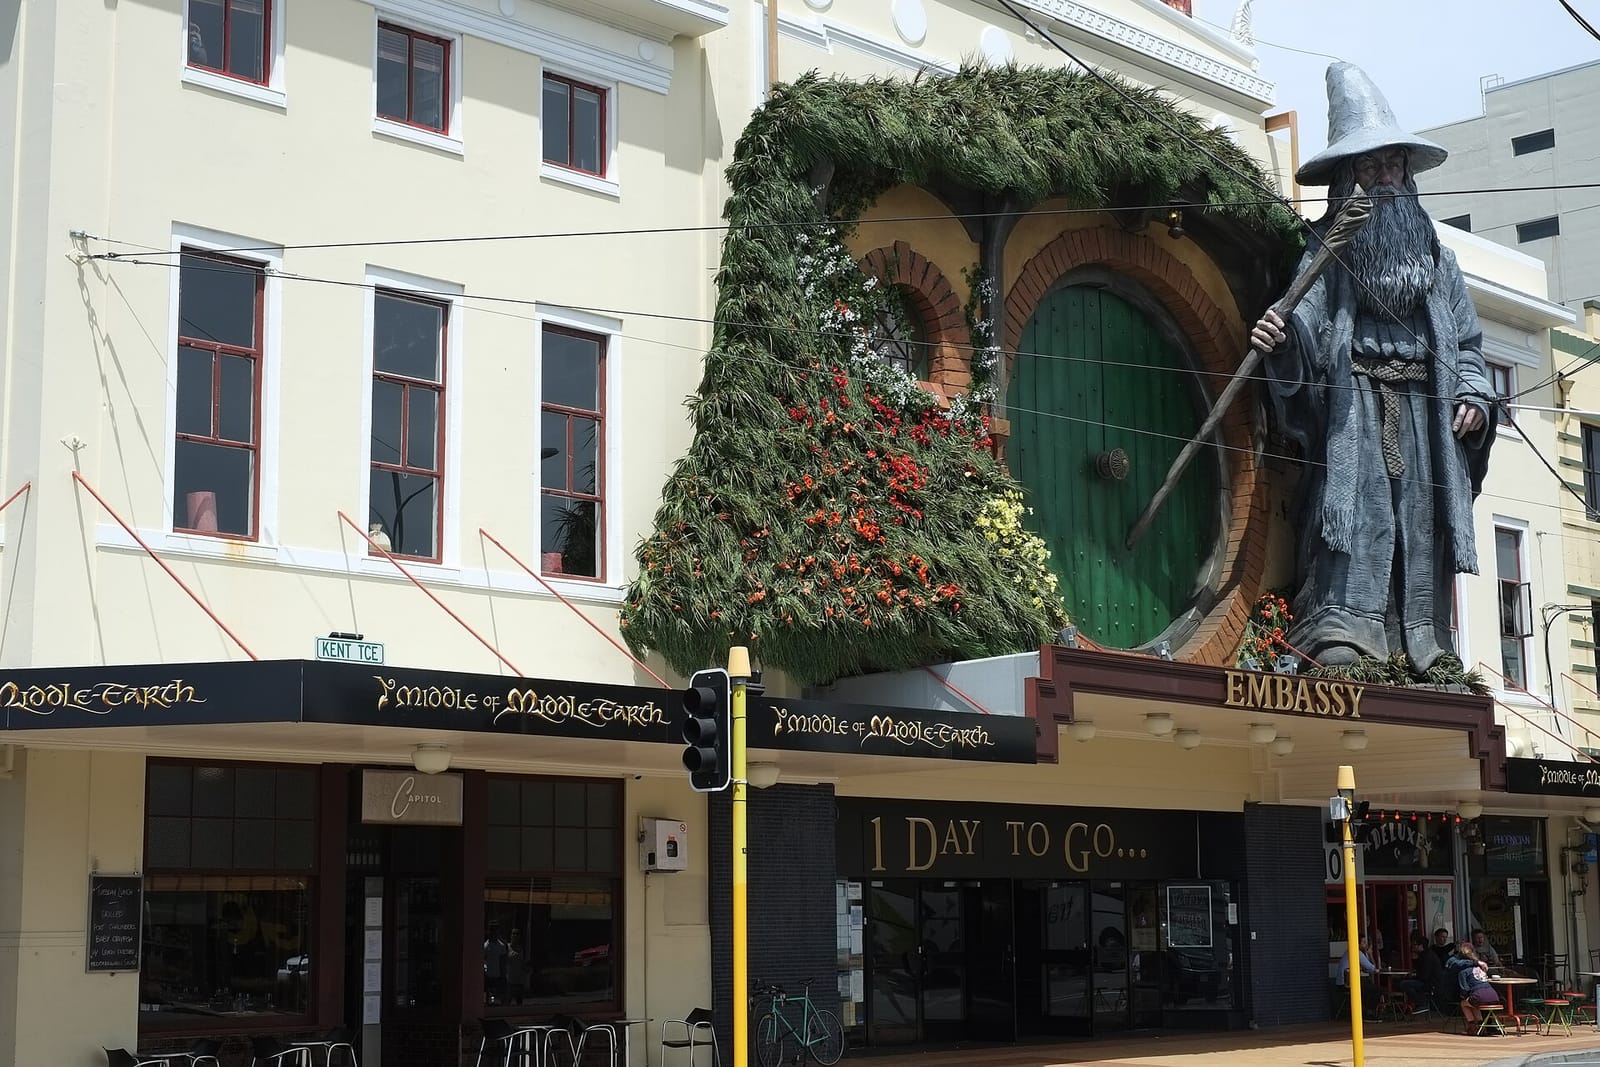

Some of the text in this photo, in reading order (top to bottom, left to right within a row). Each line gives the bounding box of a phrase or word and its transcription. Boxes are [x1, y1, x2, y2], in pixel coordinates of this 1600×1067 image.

[322, 640, 379, 661] KENT TCE
[1224, 670, 1365, 718] EMBASSY
[870, 816, 886, 872] 1
[1371, 822, 1426, 851] DELUXE
